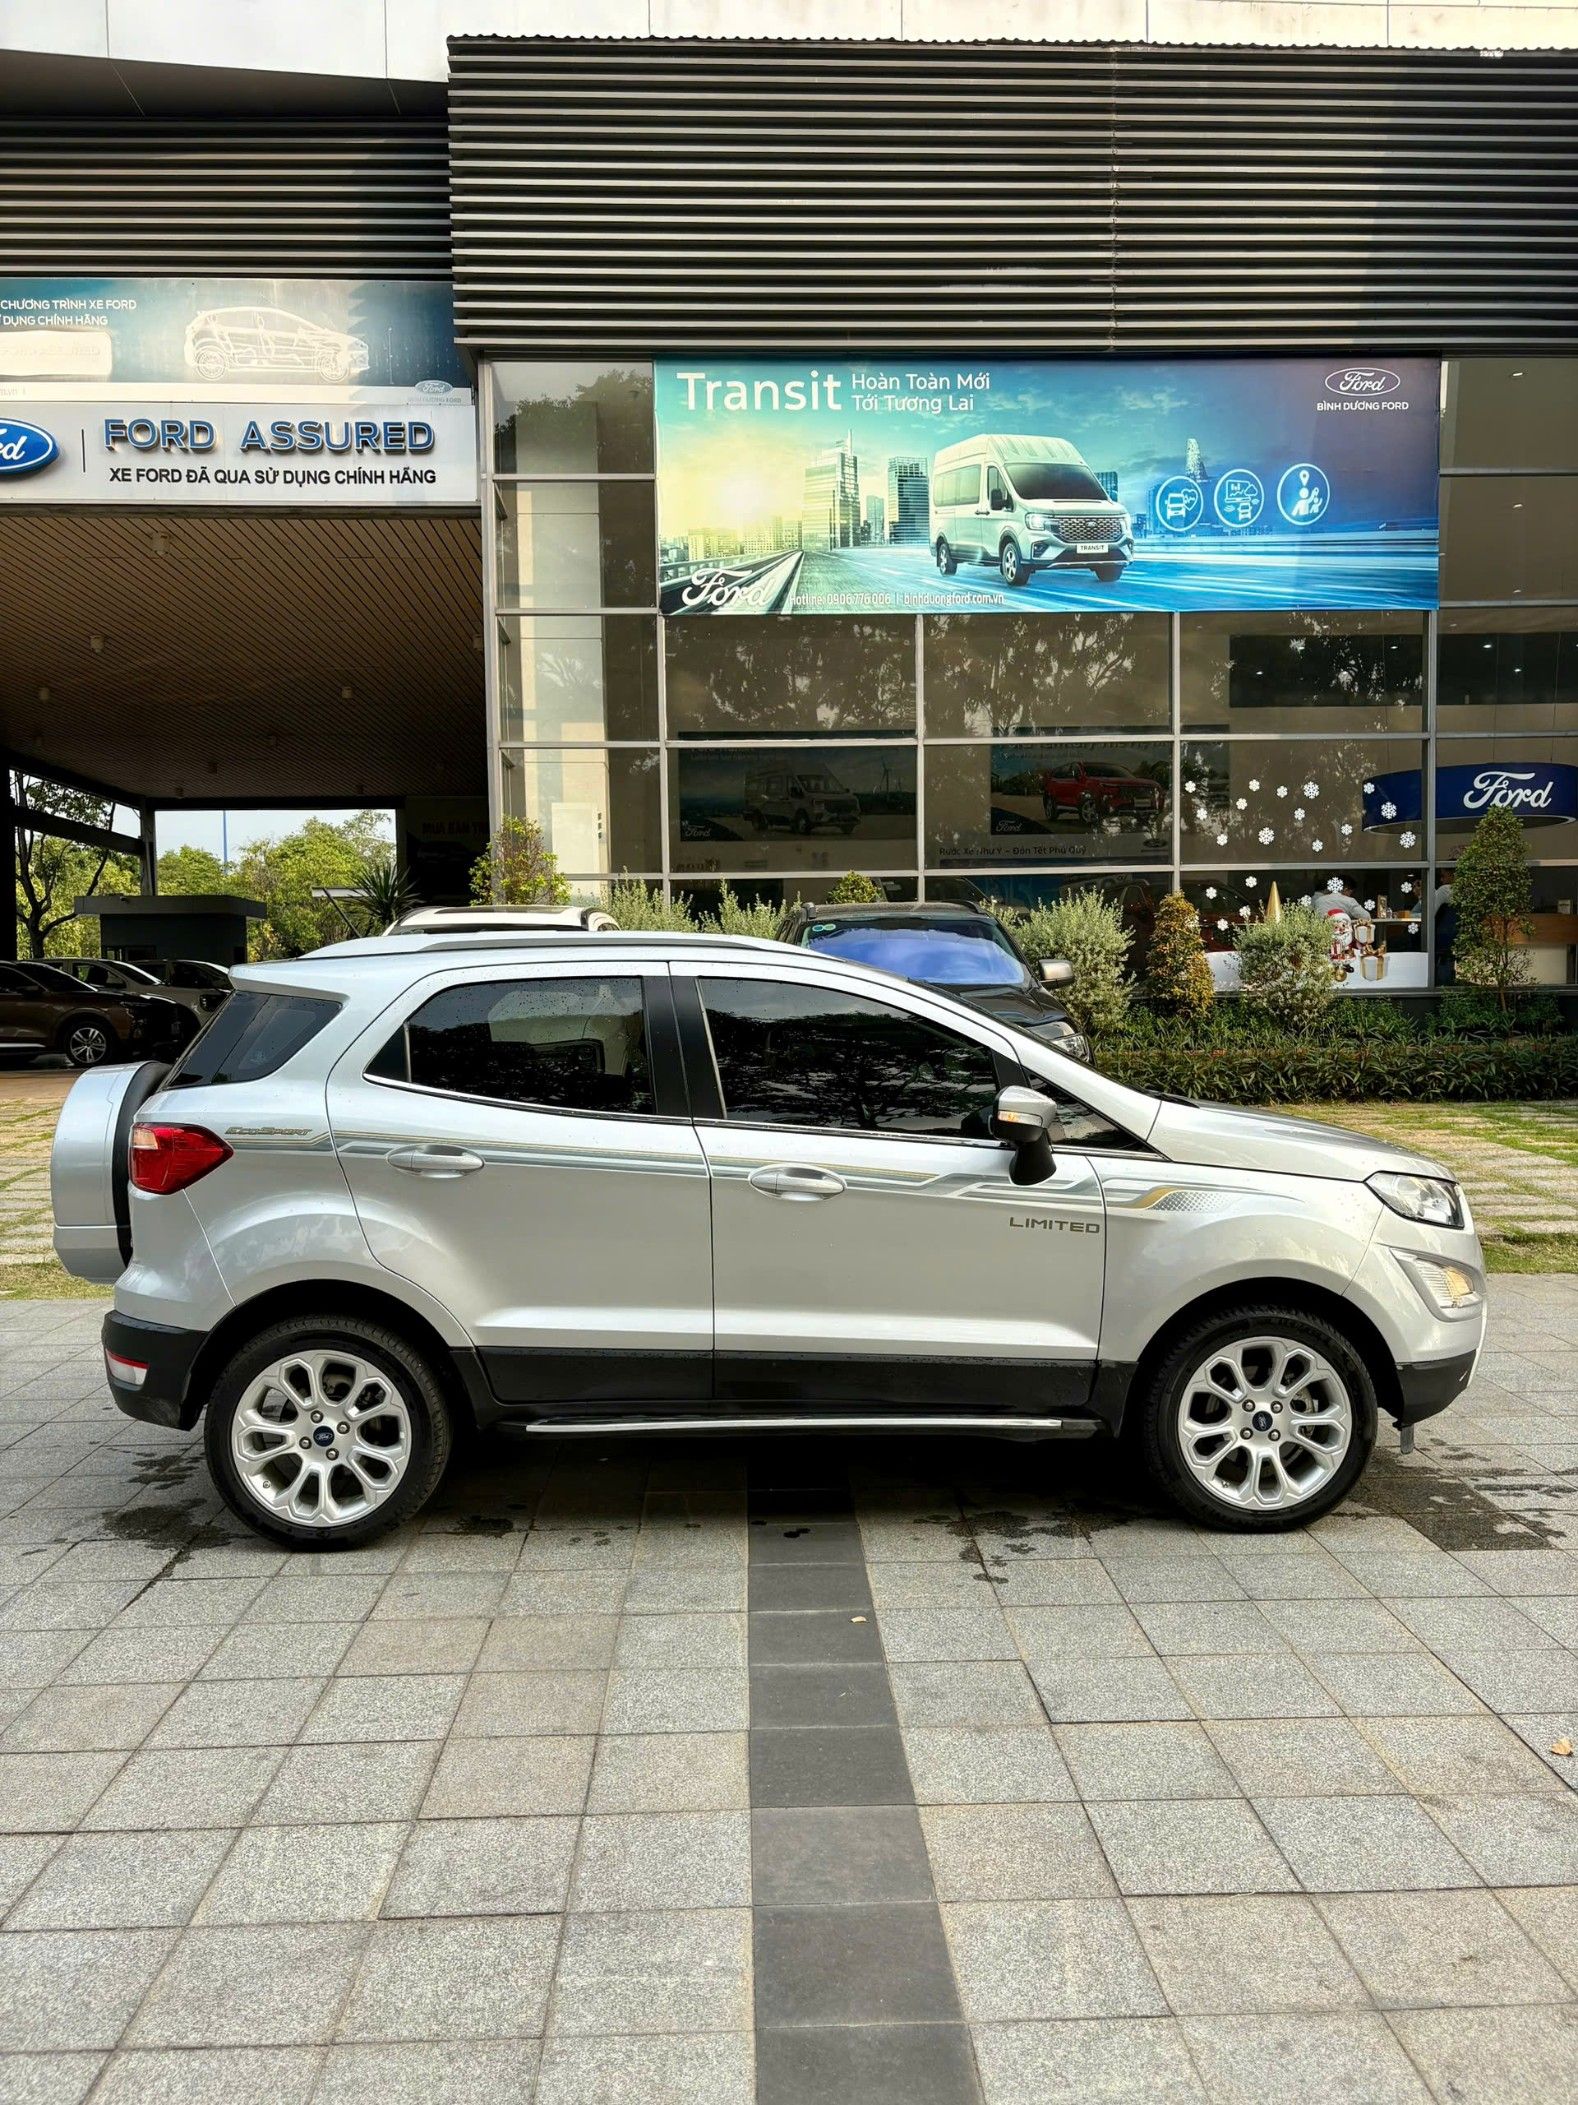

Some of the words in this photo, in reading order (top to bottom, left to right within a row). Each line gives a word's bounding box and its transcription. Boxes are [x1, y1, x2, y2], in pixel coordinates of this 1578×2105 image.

[0, 298, 50, 310] CHƯƠNG
[52, 298, 87, 310] TRÌNH
[89, 299, 104, 310] XE
[105, 299, 137, 310] FORD
[3, 315, 35, 327] DỤNG
[38, 313, 73, 326] CHÍNH
[676, 370, 842, 411] Transit
[852, 372, 900, 390] Hoàn
[905, 373, 950, 390] Toàn
[957, 372, 990, 390] Mới
[1339, 371, 1386, 392] Ford
[851, 394, 879, 411] Tới
[884, 395, 941, 414] Tương
[949, 394, 974, 411] Lai
[1316, 400, 1342, 411] BÌNH
[1343, 400, 1380, 411] DƯƠNG
[1381, 401, 1409, 411] FORD
[104, 418, 217, 453] FORD
[241, 421, 436, 455] ASSURED
[109, 468, 132, 483] XE
[136, 468, 182, 484] FORD
[186, 466, 210, 484] ĐÃ
[214, 469, 250, 484] QUA
[254, 467, 279, 485] SỬ
[283, 469, 330, 487] DỤNG
[334, 467, 385, 485] CHÍNH
[389, 466, 437, 485] HÃNG
[682, 568, 776, 607] Ford
[904, 591, 1004, 606] binhduongford.com.vn
[1463, 771, 1554, 809] Ford
[1009, 1217, 1100, 1233] LIMITED
